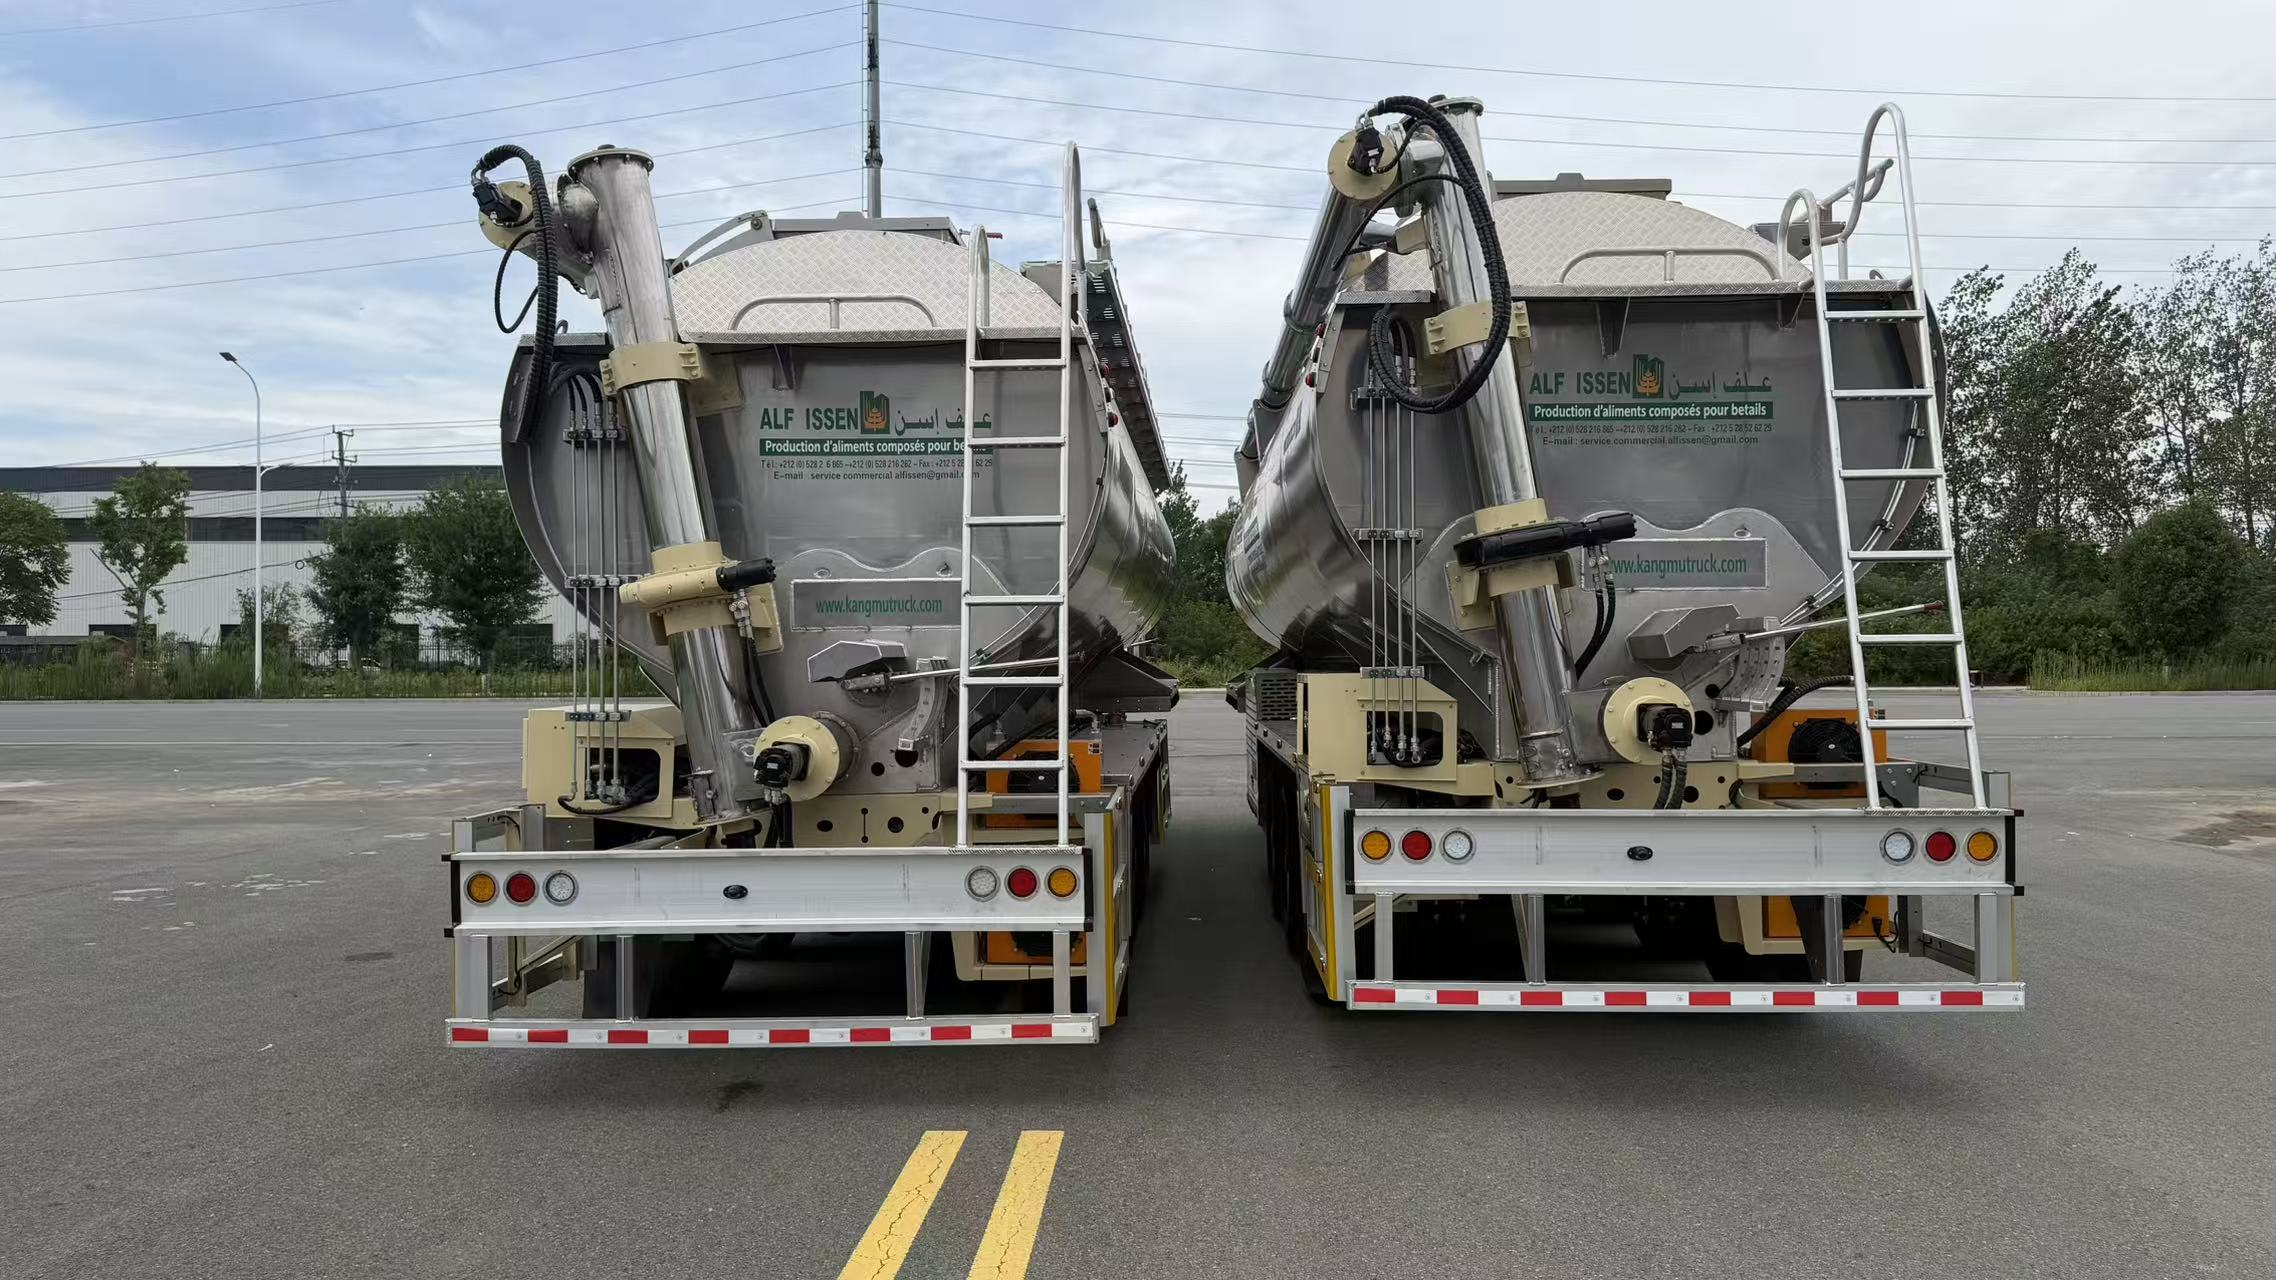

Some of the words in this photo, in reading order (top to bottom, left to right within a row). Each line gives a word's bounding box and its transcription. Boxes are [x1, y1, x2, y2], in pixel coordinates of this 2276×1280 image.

[1529, 372, 1565, 395] ALF
[1576, 371, 1631, 395] ISSEN
[1723, 371, 1772, 392] علف
[760, 408, 795, 430] ALF
[806, 408, 859, 430] ISSEN
[945, 407, 992, 429] عف
[1534, 404, 1591, 418] Production
[1593, 404, 1647, 418] d'aliments
[1648, 403, 1701, 419] composés
[1703, 405, 1729, 419] pour
[1731, 402, 1767, 417] betails
[765, 440, 820, 453] Production
[823, 440, 875, 453] d'aliments
[876, 439, 926, 454] composés
[928, 440, 952, 454] pour
[815, 595, 943, 617] www.kangmutruck.com
